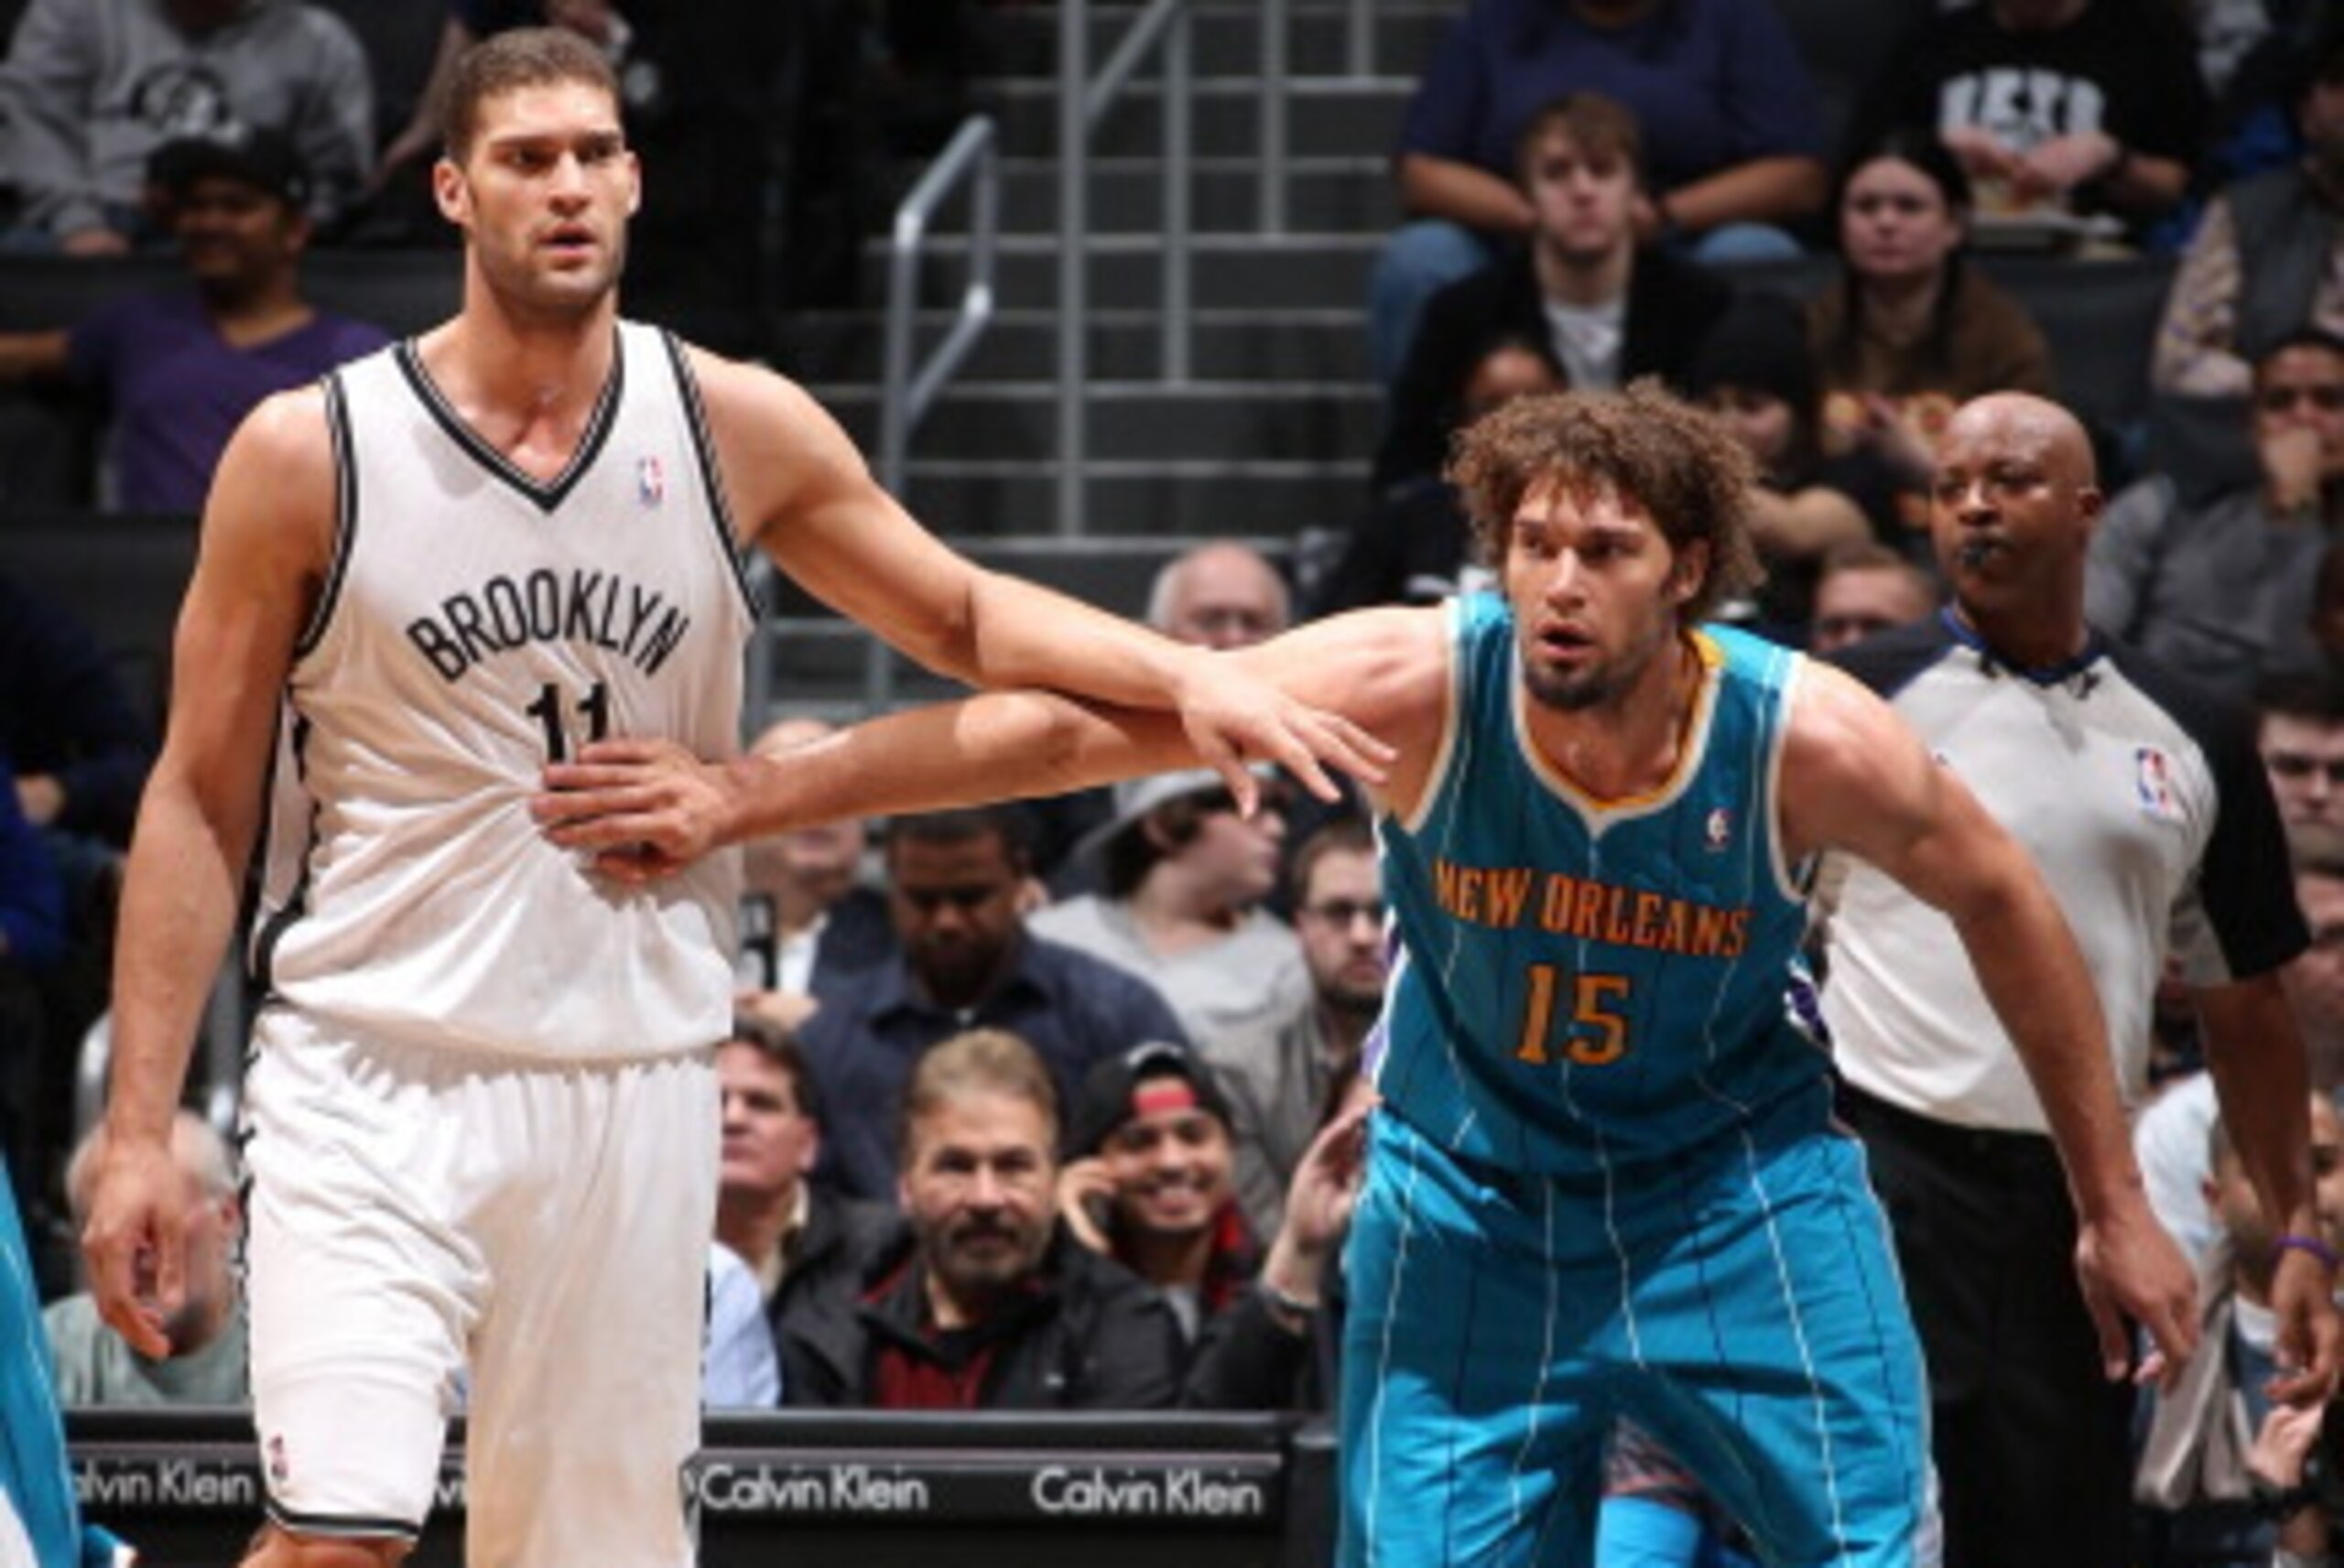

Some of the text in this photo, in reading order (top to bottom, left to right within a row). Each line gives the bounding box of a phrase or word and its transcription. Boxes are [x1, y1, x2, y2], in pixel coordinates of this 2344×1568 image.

[406, 568, 690, 683] BROOKLYN
[526, 681, 609, 763] 11
[1434, 858, 1754, 957] NEW ORLEANS
[1515, 963, 1630, 1065] 15
[74, 1461, 256, 1504] alvin Klein
[699, 1464, 929, 1509] Calvin Klein
[1031, 1466, 1262, 1515] Calvin Klein
